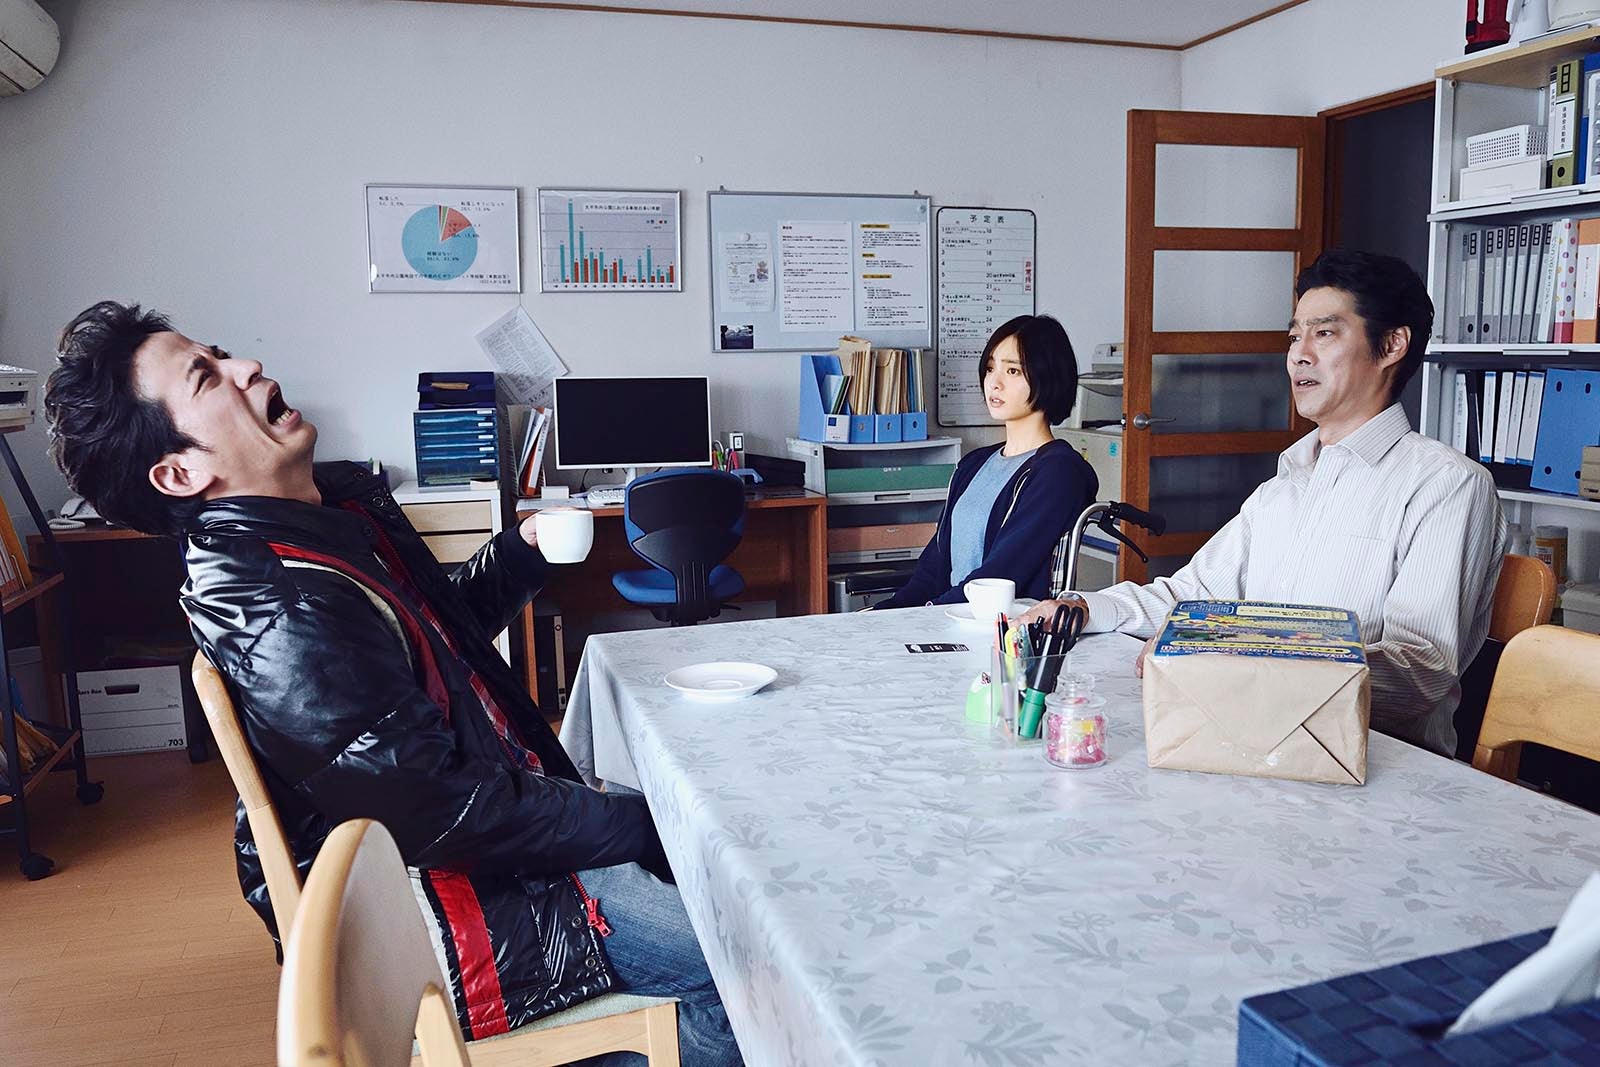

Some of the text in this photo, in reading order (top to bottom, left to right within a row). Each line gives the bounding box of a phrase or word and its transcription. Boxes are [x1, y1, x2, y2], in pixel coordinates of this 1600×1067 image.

[969, 214, 1006, 224] 予定表
[168, 738, 184, 747] 703
